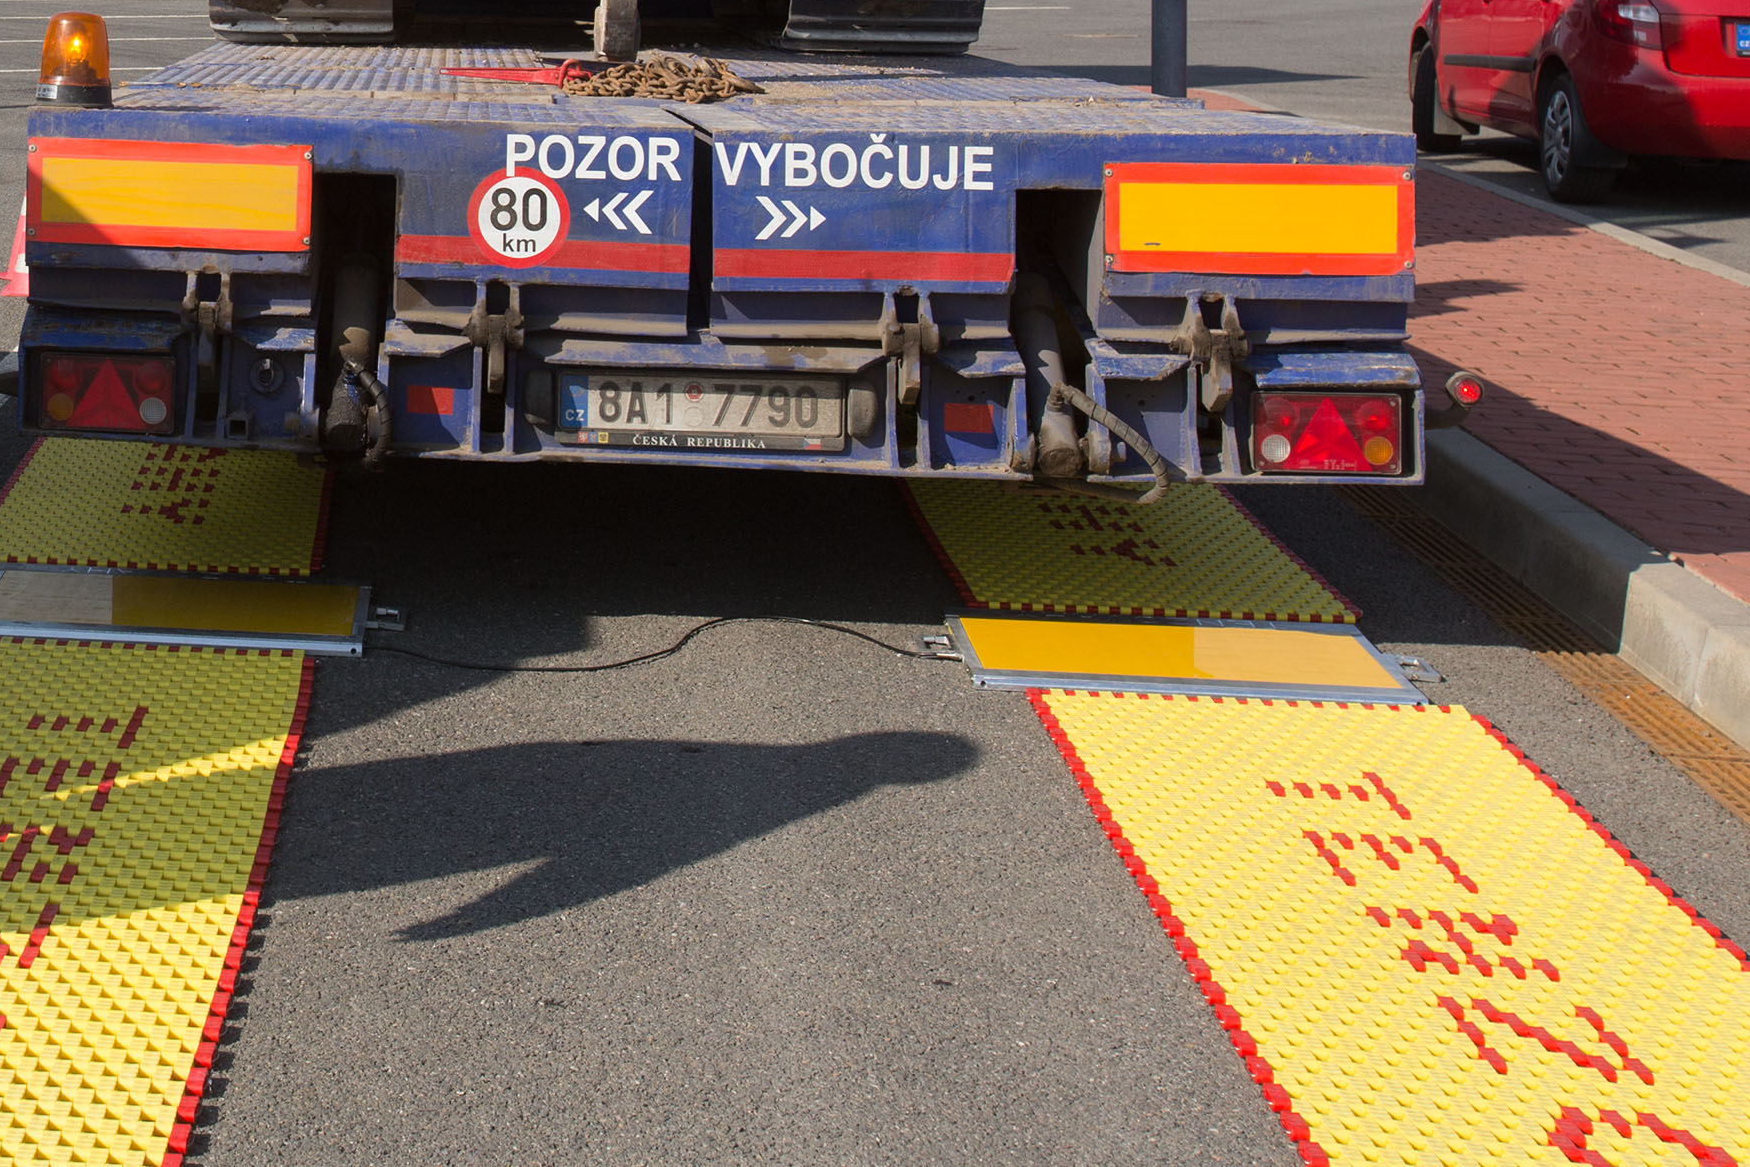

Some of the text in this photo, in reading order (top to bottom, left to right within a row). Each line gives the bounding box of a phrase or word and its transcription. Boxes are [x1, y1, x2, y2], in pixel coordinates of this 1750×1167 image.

[505, 133, 994, 192] POZOR VYBOČUJE
[490, 187, 547, 232] 80
[503, 233, 536, 252] km
[564, 408, 585, 422] CZ
[598, 381, 819, 429] 8A1 7790
[632, 434, 766, 449] ČESKÁ REPUBLIKA
